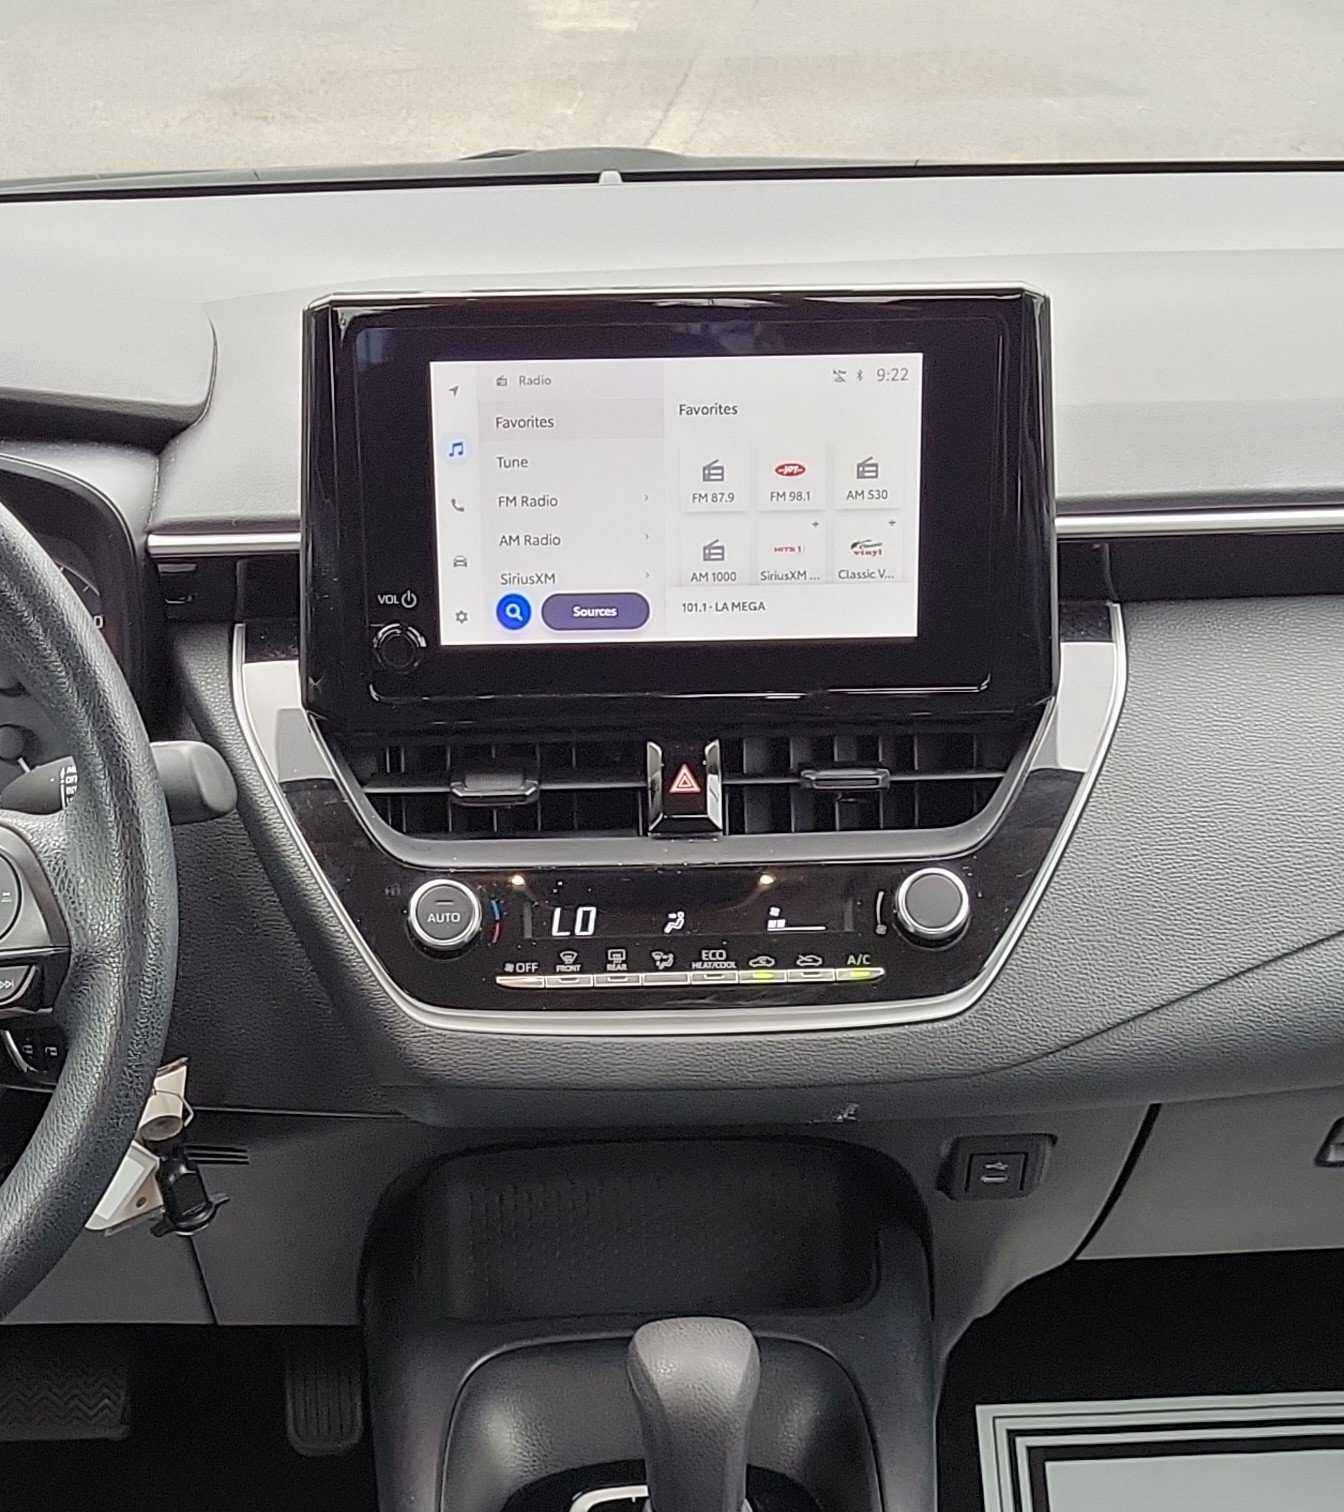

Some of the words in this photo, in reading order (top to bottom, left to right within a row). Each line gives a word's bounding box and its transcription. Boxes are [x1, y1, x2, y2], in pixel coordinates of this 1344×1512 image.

[518, 374, 552, 387] Radio
[876, 367, 910, 382] 9:22
[678, 402, 738, 416] Favorites
[495, 414, 555, 429] Favorites
[497, 456, 529, 469] Tune
[498, 496, 517, 508] FM
[521, 494, 559, 508] Radio
[692, 492, 709, 503] FM
[711, 492, 735, 503] 87.9
[770, 491, 787, 502] FM
[790, 490, 811, 502] 98.1
[846, 489, 865, 501] AM
[867, 489, 889, 500] 530
[499, 535, 521, 547] AM
[524, 533, 562, 547] Radio
[500, 572, 556, 586] SiriusXM
[690, 572, 709, 583] AM
[711, 571, 737, 582] 1000
[760, 569, 807, 581] SiriusXM
[838, 569, 875, 580] Classic
[377, 594, 400, 605] VOL
[572, 605, 618, 618] Sources
[682, 602, 707, 613] 101.1
[715, 601, 730, 612] LA
[731, 601, 766, 612] MEGA
[427, 912, 461, 924] AUTO
[551, 907, 597, 936] LO
[701, 950, 727, 961] ECO
[847, 954, 871, 966] A/C
[516, 962, 539, 973] OFF
[556, 964, 581, 973] FRONT
[606, 963, 628, 972] REAR
[691, 960, 737, 969] HEAT/COOL
